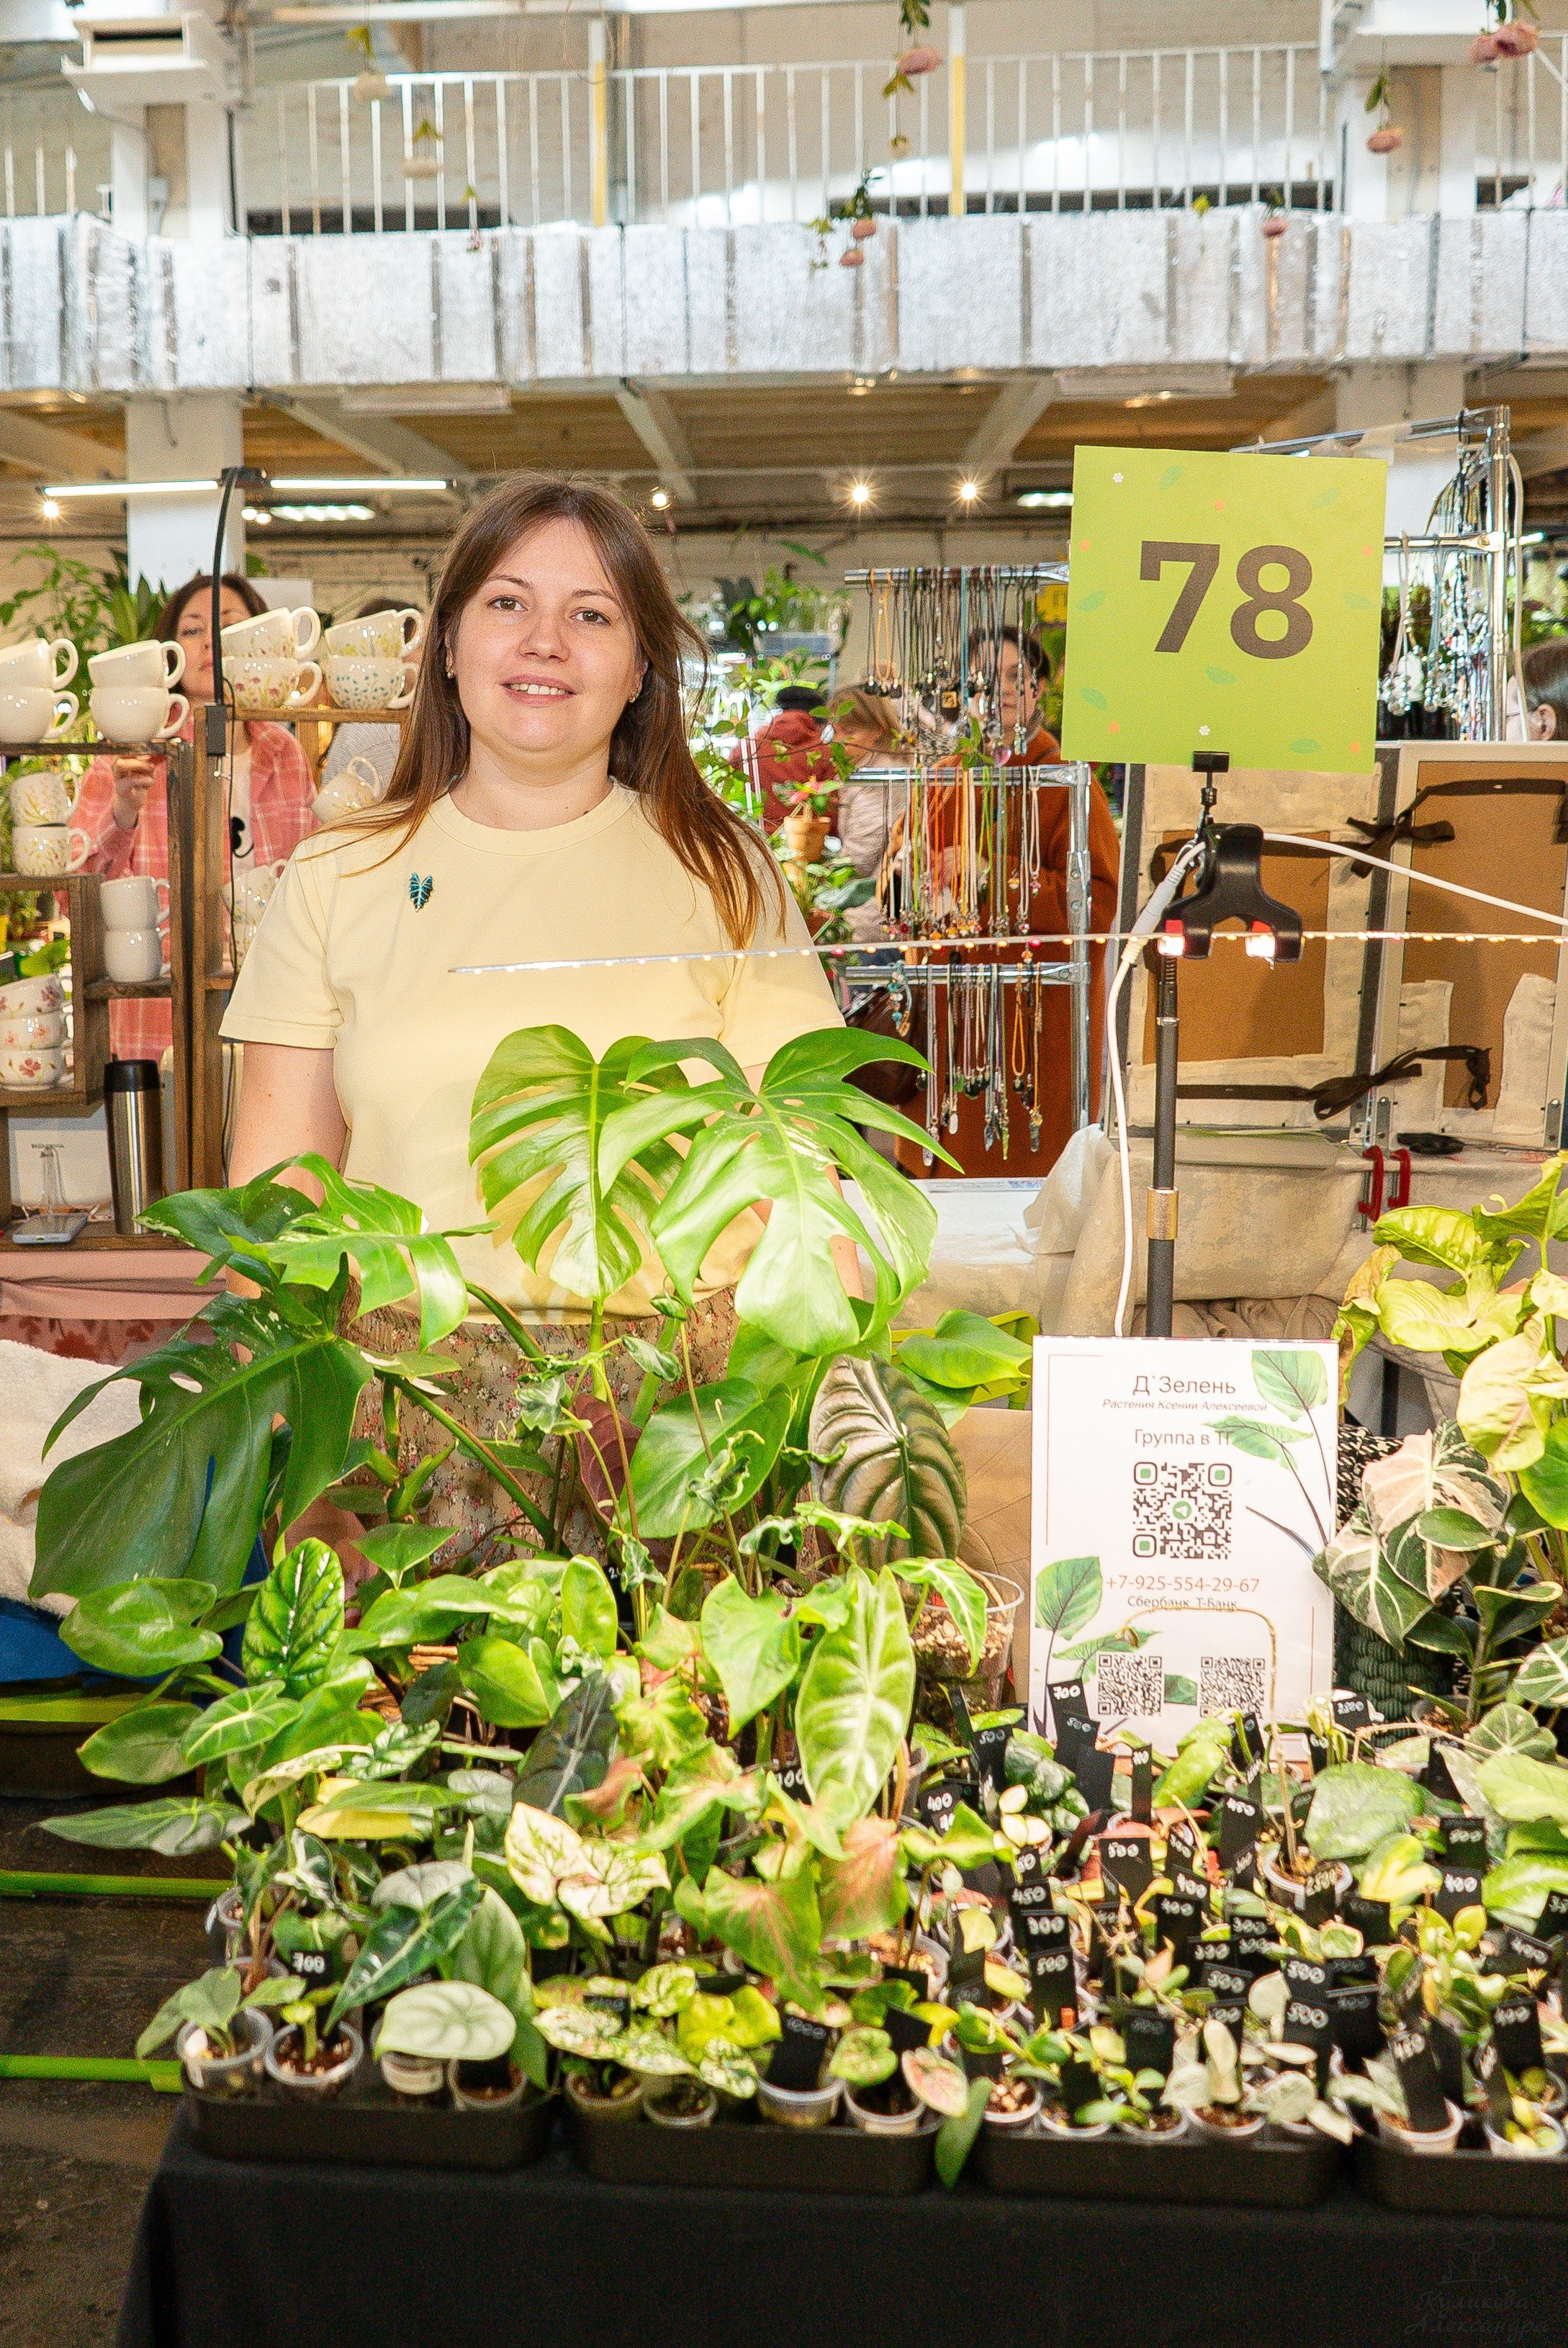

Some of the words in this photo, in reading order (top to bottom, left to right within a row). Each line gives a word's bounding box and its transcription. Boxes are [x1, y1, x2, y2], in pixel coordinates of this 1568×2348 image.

[1139, 540, 1313, 660] 78
[1102, 1398, 1155, 1410] Растения
[1158, 1400, 1198, 1411] Ксении
[1200, 1400, 1268, 1412] Алексеевой
[1134, 1429, 1195, 1448] Группа
[1201, 1434, 1210, 1445] в
[1106, 1575, 1260, 1593] +7-925-554-29-67
[1053, 1684, 1081, 1700] 700
[980, 1729, 1005, 1745] 500
[927, 1792, 953, 1812] 400
